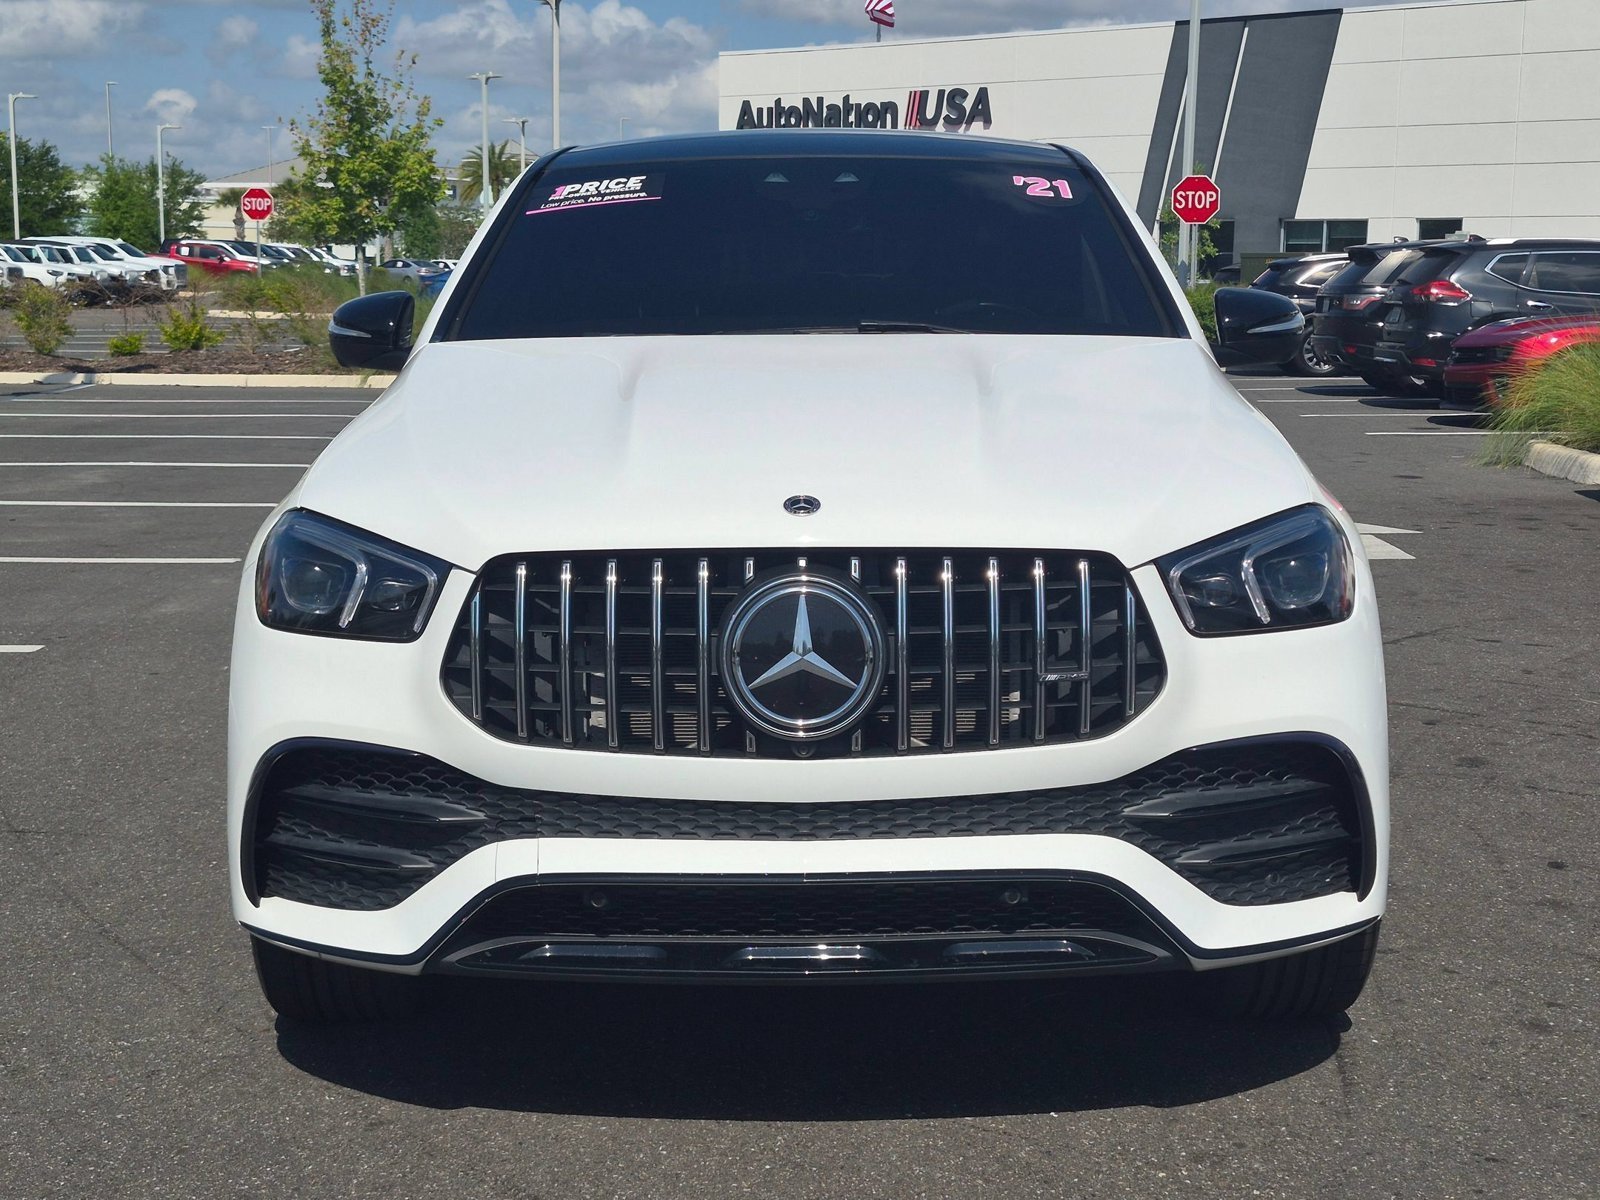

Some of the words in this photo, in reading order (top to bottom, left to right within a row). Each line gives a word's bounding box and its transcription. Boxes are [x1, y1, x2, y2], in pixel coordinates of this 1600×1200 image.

[736, 94, 899, 129] AutoNation
[919, 87, 992, 126] USA
[243, 197, 271, 211] STOP
[540, 201, 560, 209] Low
[1175, 191, 1217, 208] STOP
